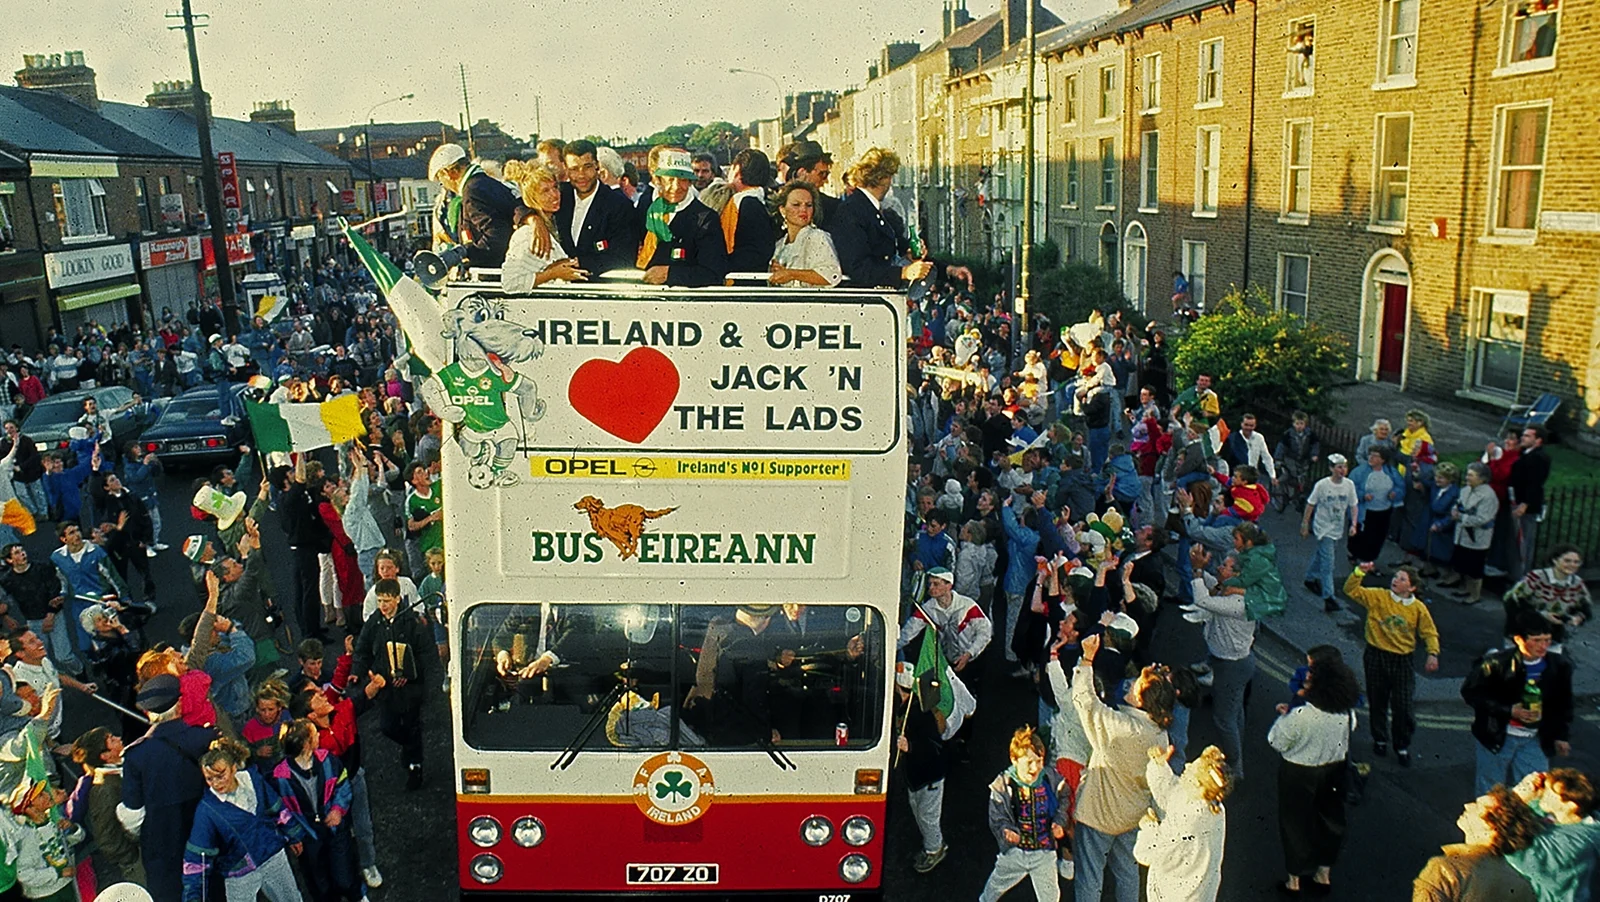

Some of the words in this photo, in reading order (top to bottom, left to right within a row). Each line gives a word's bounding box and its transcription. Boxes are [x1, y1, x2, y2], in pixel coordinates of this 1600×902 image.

[220, 154, 237, 206] SPAR
[102, 252, 125, 271] GOOD
[538, 320, 702, 346] IRELAND
[719, 322, 743, 348] &
[766, 323, 862, 349] OPEL
[710, 365, 808, 391] JACK
[451, 395, 494, 406] OPEL
[674, 405, 744, 430] THE
[766, 406, 862, 431] LADS
[545, 459, 627, 476] OPEL
[677, 460, 737, 474] Ireland's
[769, 461, 846, 478] Supporter!
[532, 531, 604, 563] BUS
[638, 533, 816, 564] EIREANN
[640, 767, 650, 778] F
[646, 805, 702, 823] IRELAND
[637, 867, 676, 882] 707
[683, 867, 709, 882] ZO
[819, 894, 851, 902] D707
